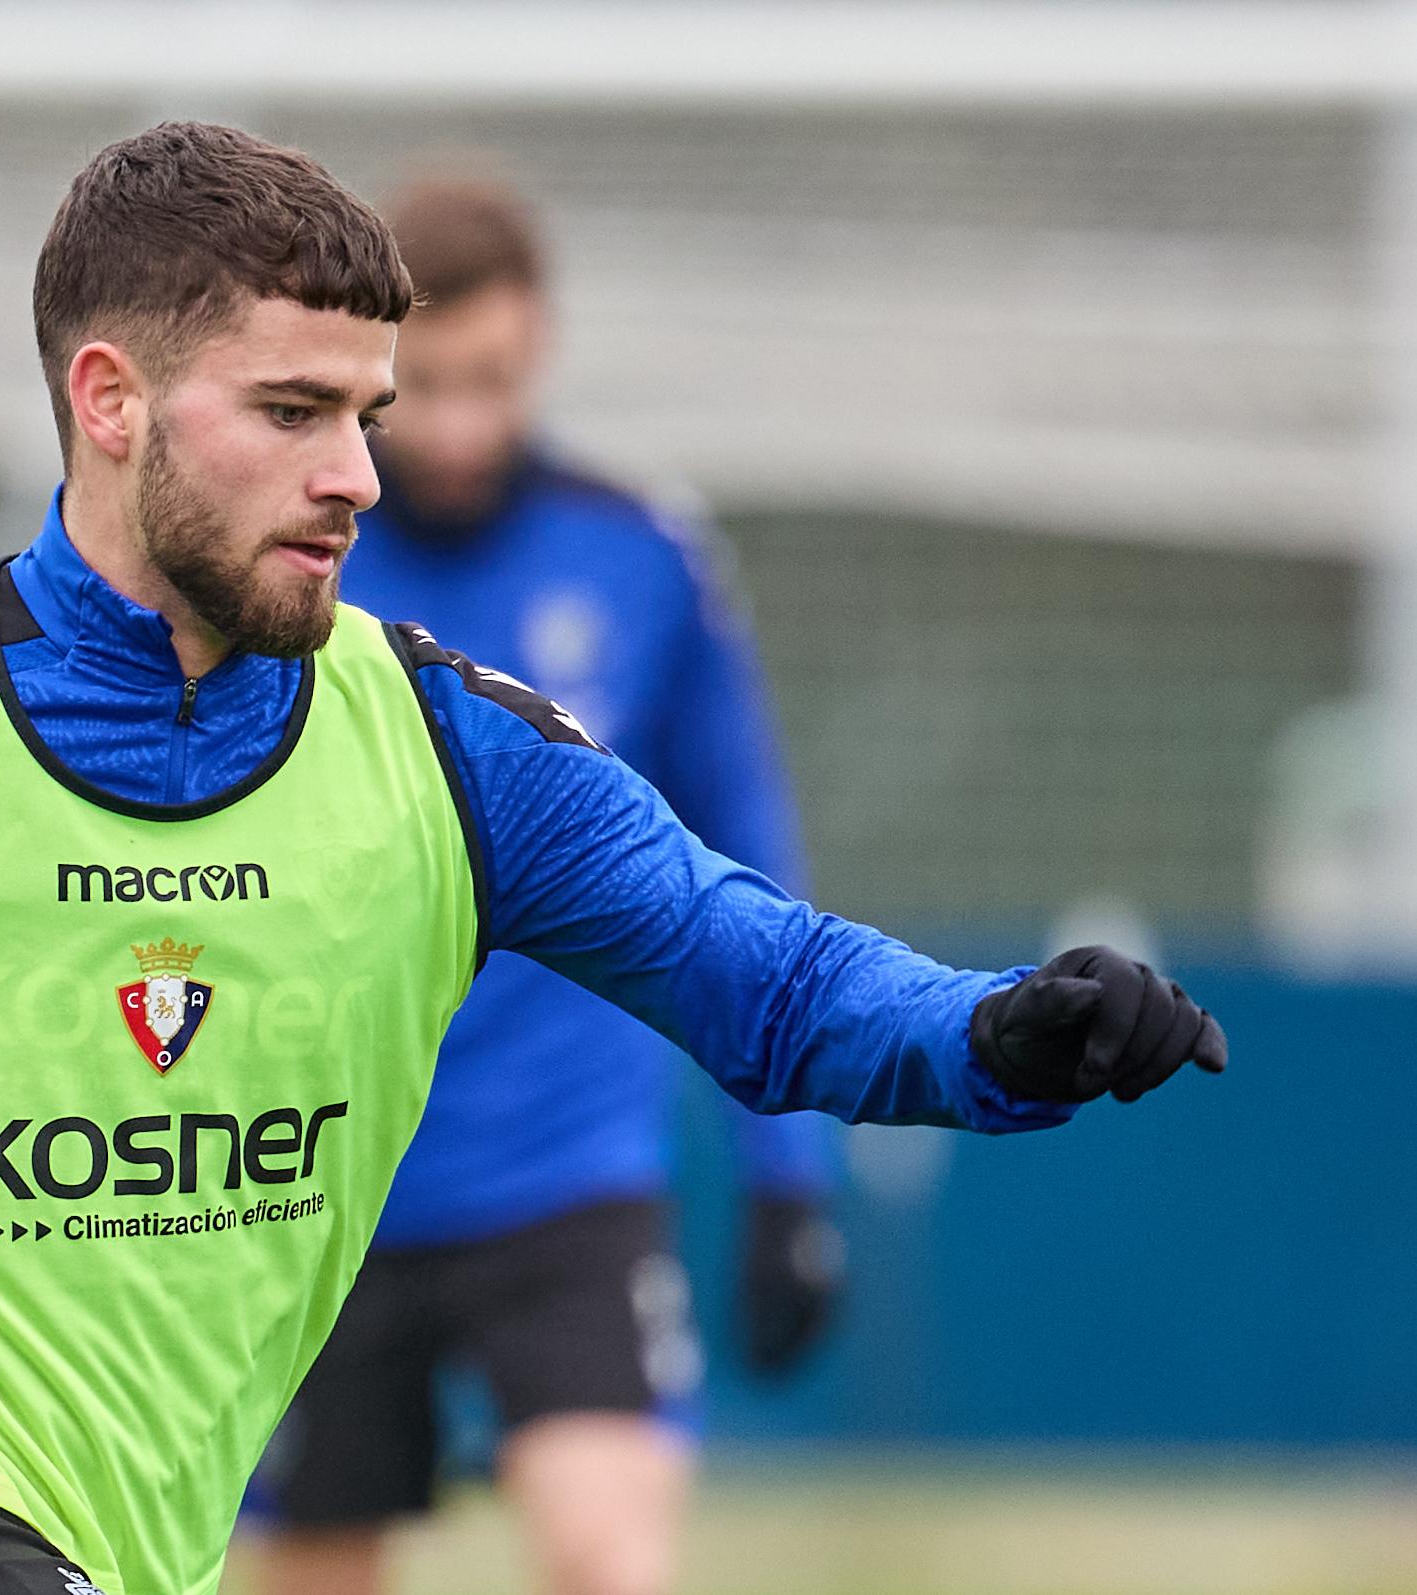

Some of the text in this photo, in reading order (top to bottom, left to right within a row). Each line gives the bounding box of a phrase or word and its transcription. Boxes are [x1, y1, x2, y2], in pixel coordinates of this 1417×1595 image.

[57, 863, 270, 902] macron
[127, 992, 204, 1008] C A
[157, 1051, 172, 1066] O
[63, 1192, 325, 1241] Climatización eficiente
